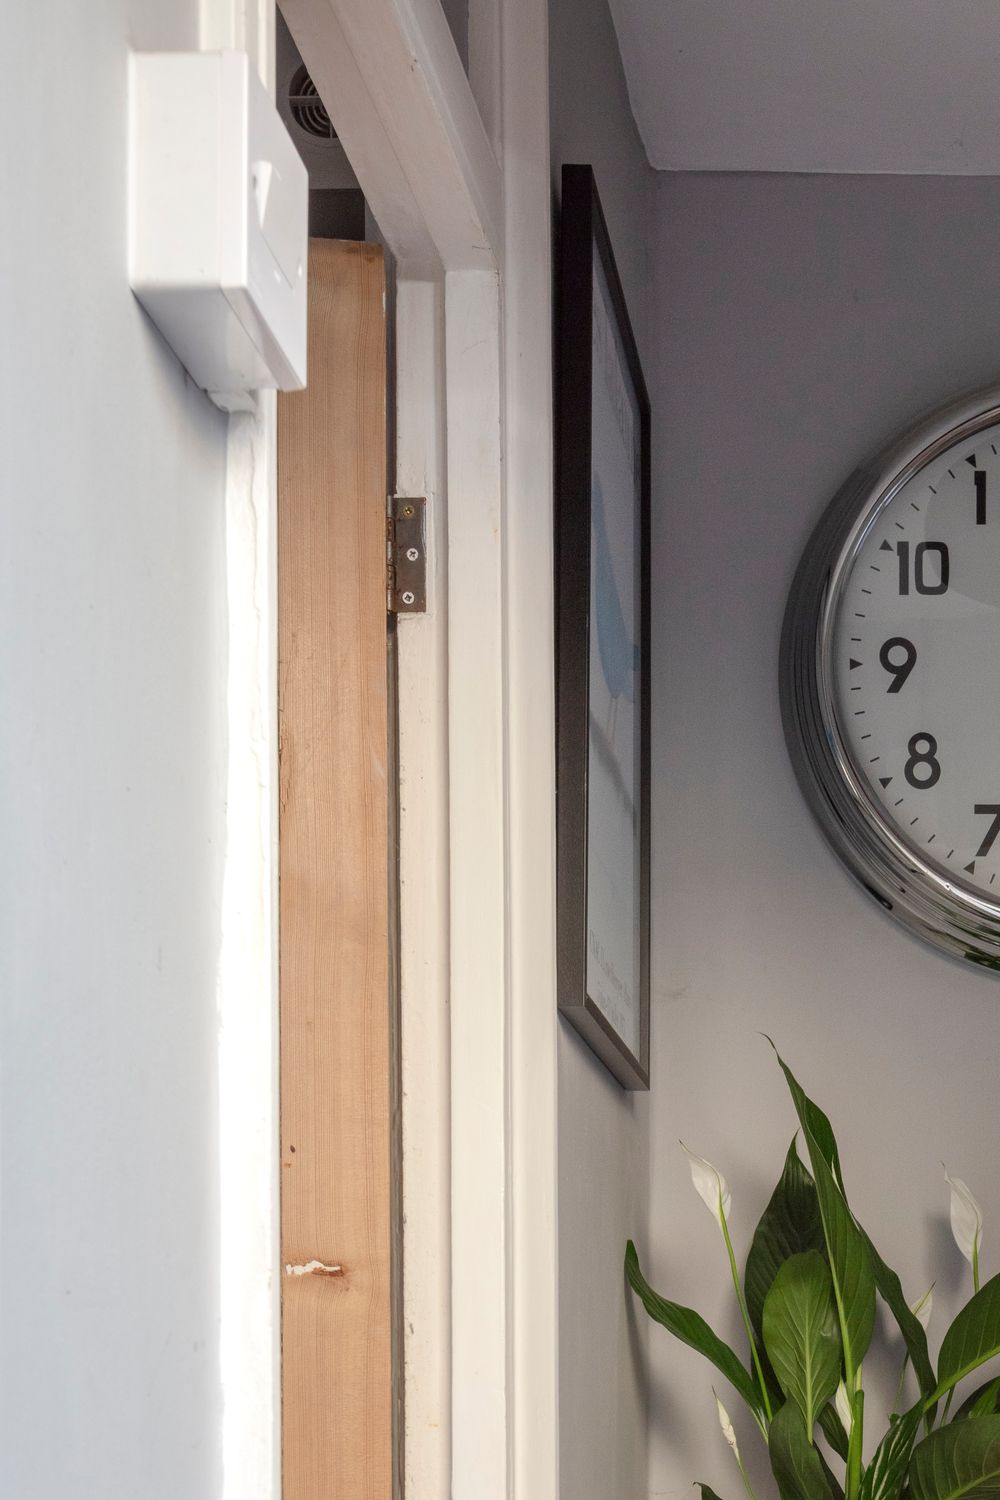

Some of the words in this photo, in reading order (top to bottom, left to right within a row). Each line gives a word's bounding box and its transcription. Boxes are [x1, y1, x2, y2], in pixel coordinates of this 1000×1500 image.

[896, 541, 950, 596] 10
[879, 637, 917, 693] 9
[904, 732, 941, 789] 8
